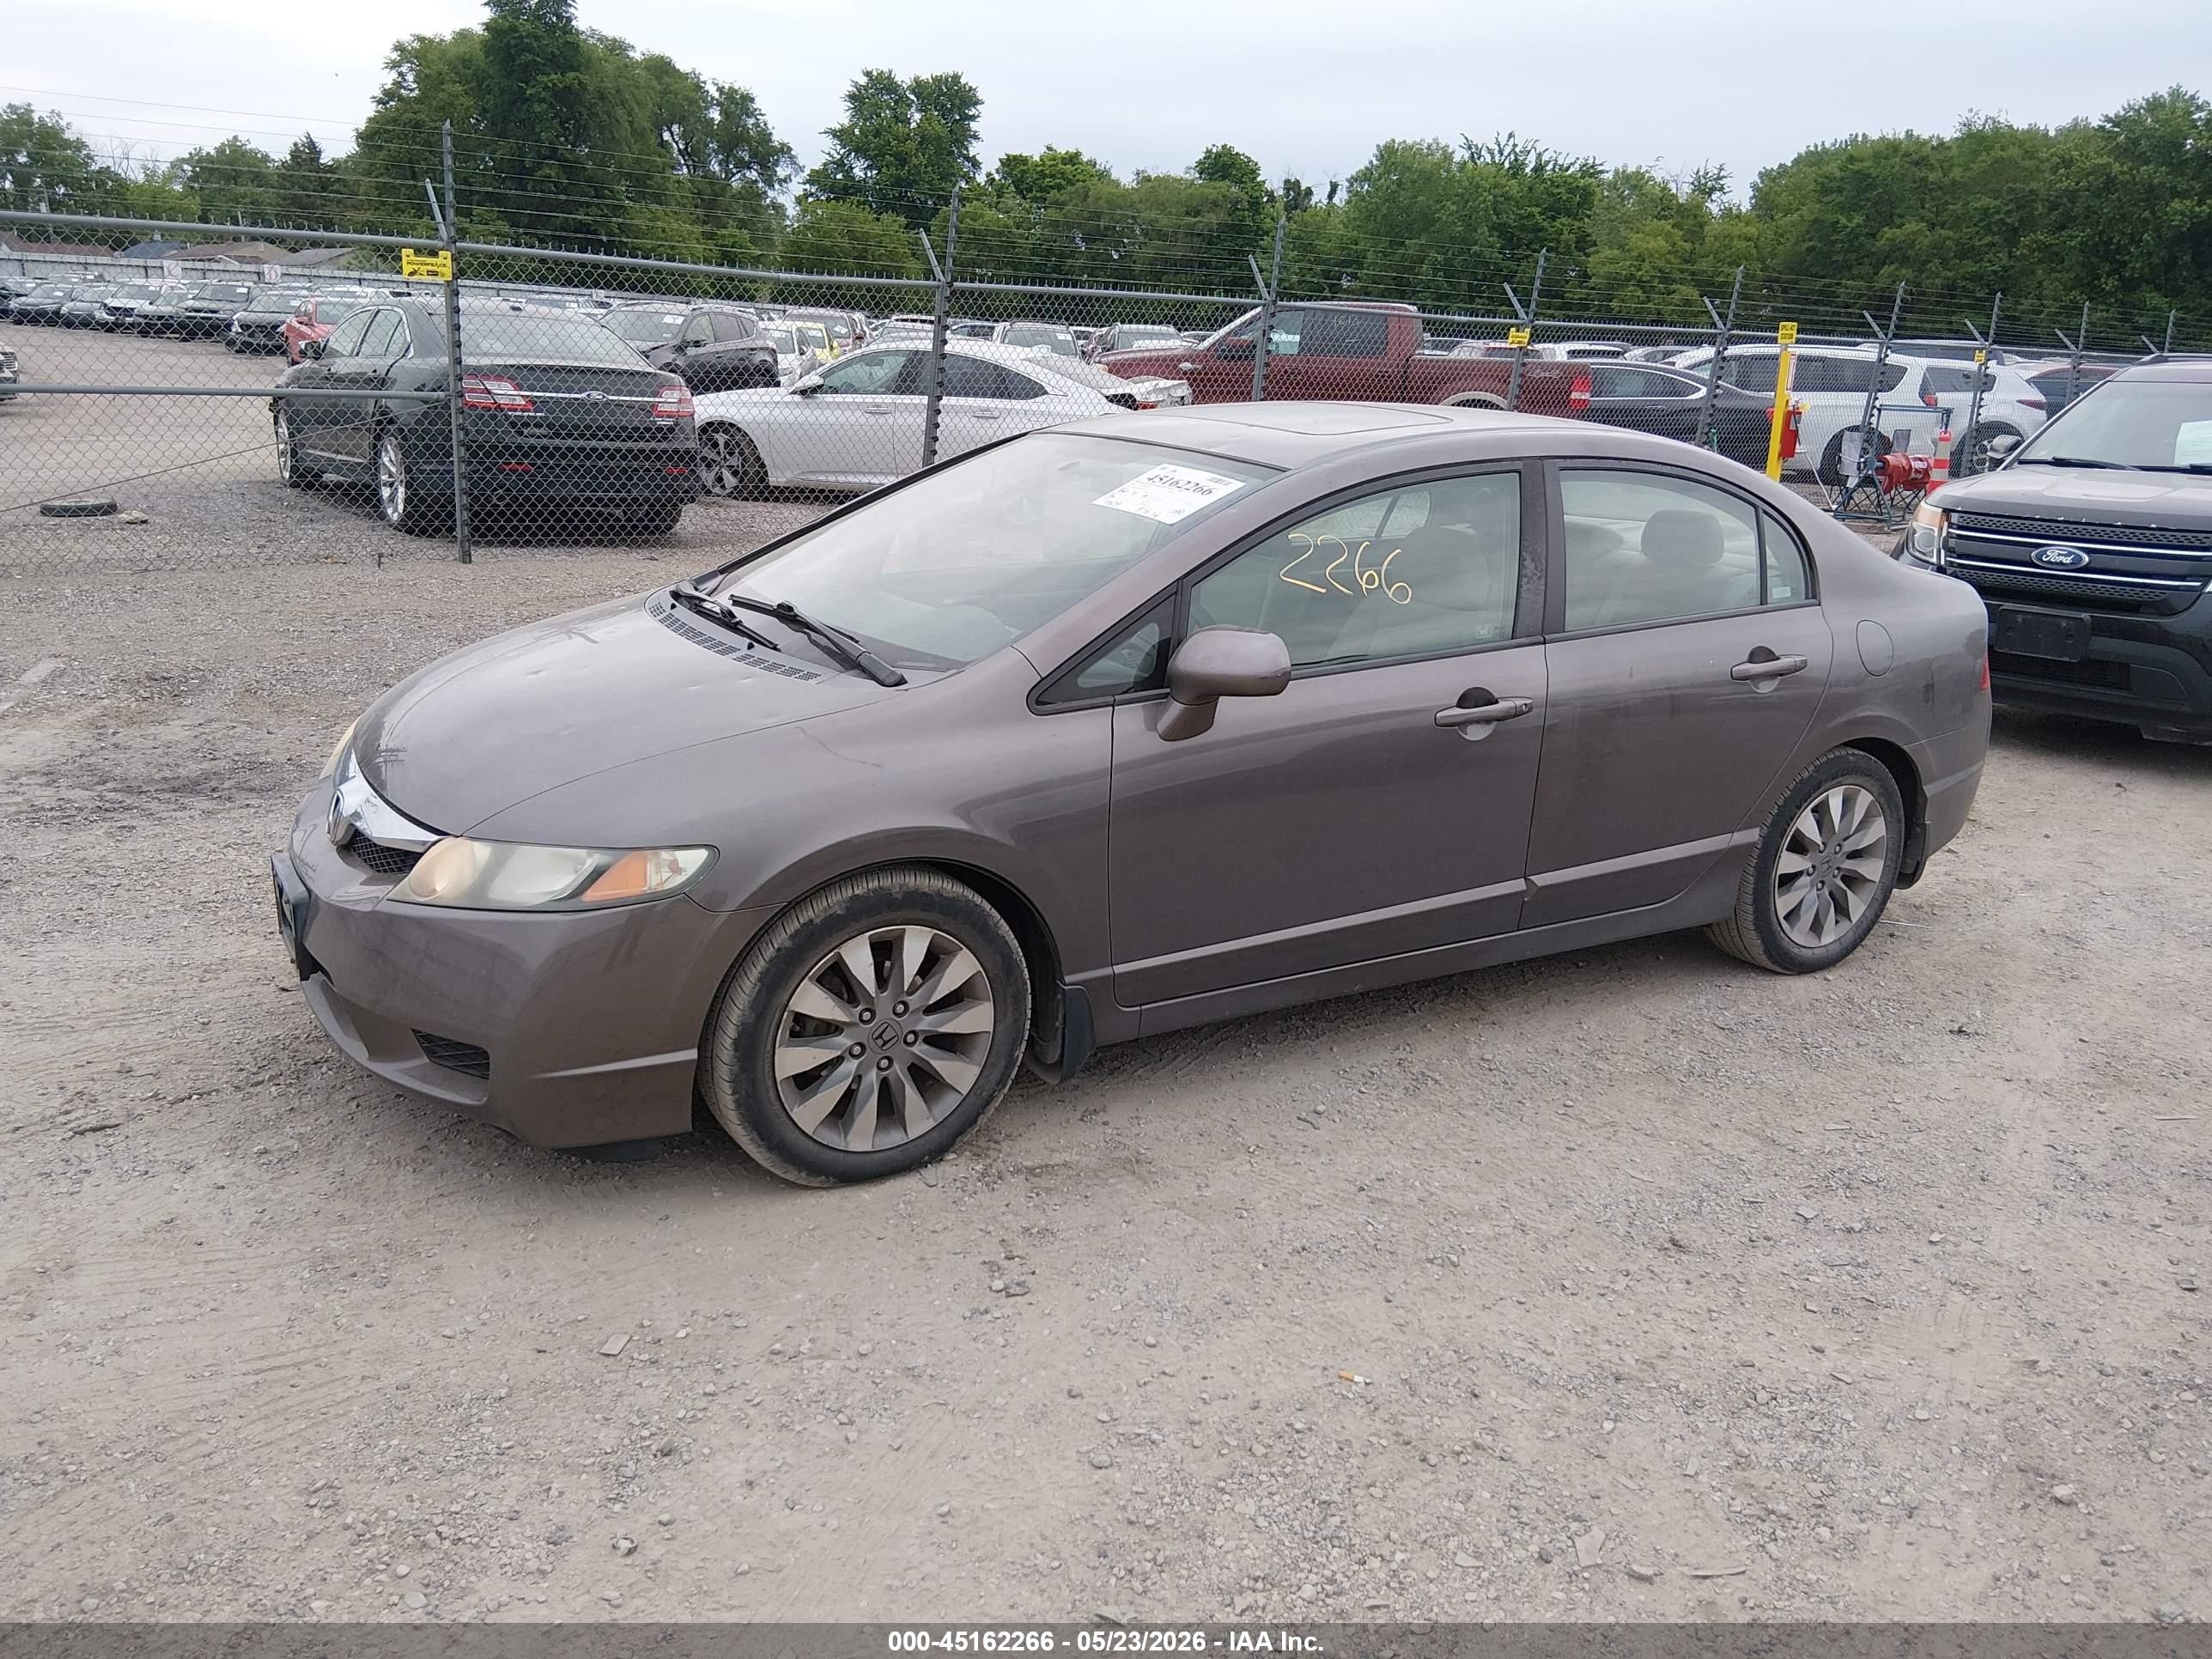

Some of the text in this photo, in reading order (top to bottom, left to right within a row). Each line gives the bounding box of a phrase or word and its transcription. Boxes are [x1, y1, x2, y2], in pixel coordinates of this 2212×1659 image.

[1146, 473, 1217, 496] 45162266
[2042, 550, 2075, 563] Ford
[1279, 532, 1413, 605] 2266
